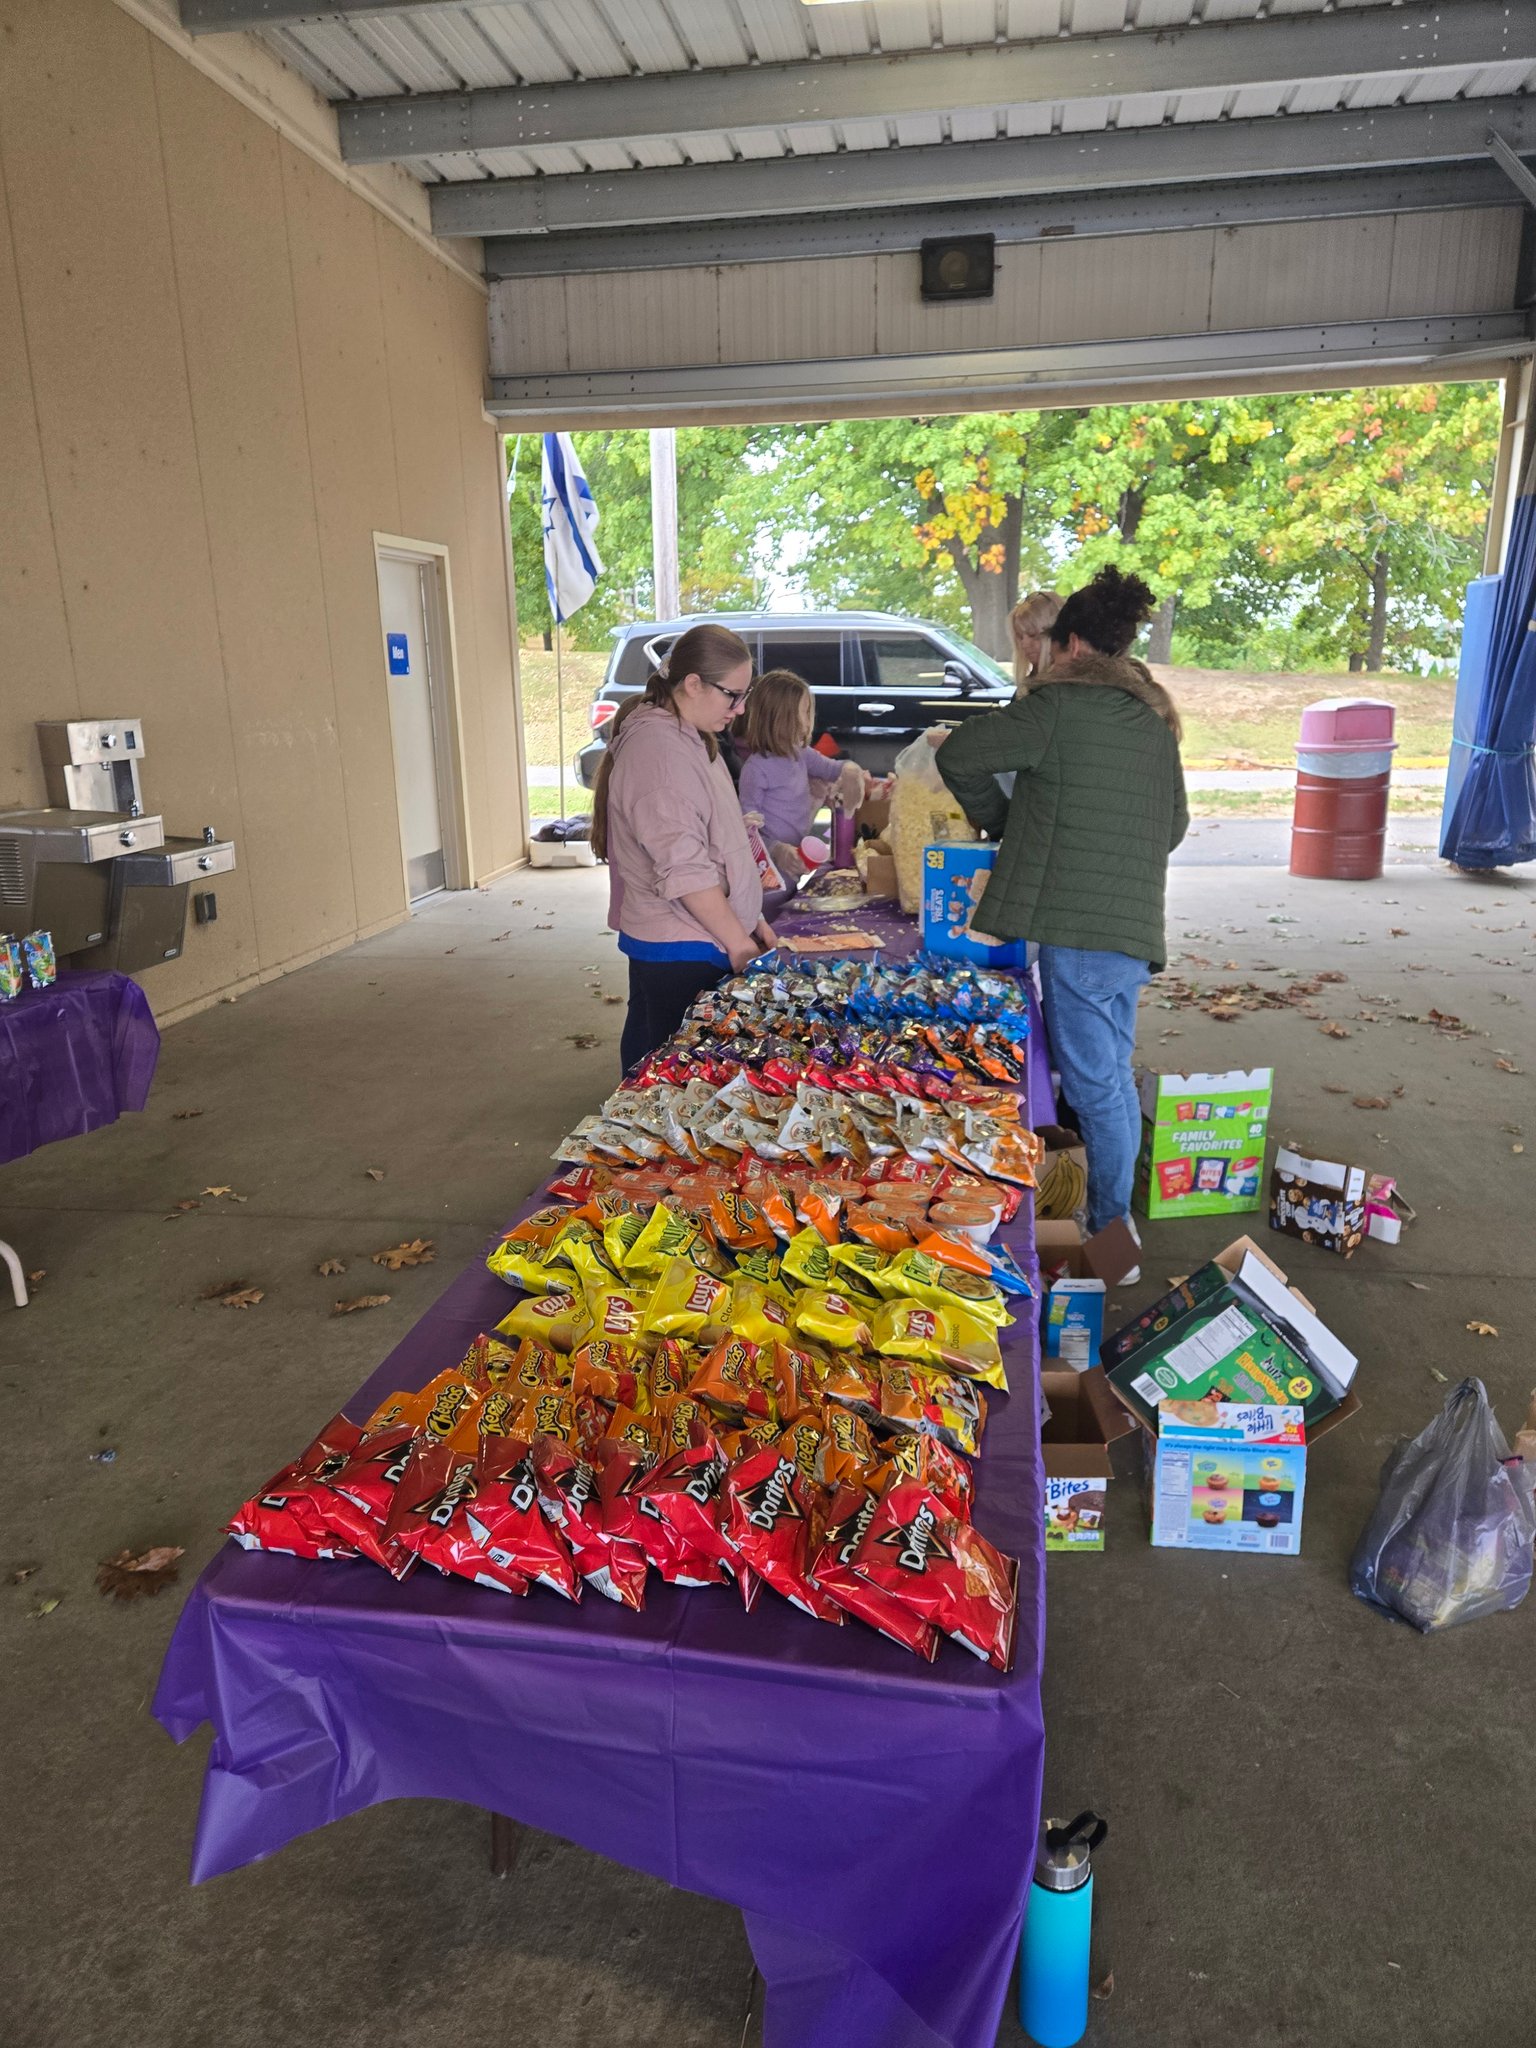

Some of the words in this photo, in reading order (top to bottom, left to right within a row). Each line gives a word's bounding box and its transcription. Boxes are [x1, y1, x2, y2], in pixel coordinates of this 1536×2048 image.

[392, 645, 404, 659] Men
[926, 850, 938, 868] 60
[1172, 1130, 1216, 1144] FAMILY
[1249, 1123, 1262, 1133] 40
[1181, 1139, 1243, 1153] FAVORITES
[687, 1276, 718, 1314] Lay's
[951, 1324, 960, 1349] Classic
[655, 1352, 675, 1397] Cheetos
[429, 1386, 465, 1436] Cheetos
[1237, 1406, 1264, 1421] Bites
[1247, 1415, 1273, 1434] Little
[751, 1458, 796, 1531] Doritos
[1051, 1480, 1089, 1499] Bites
